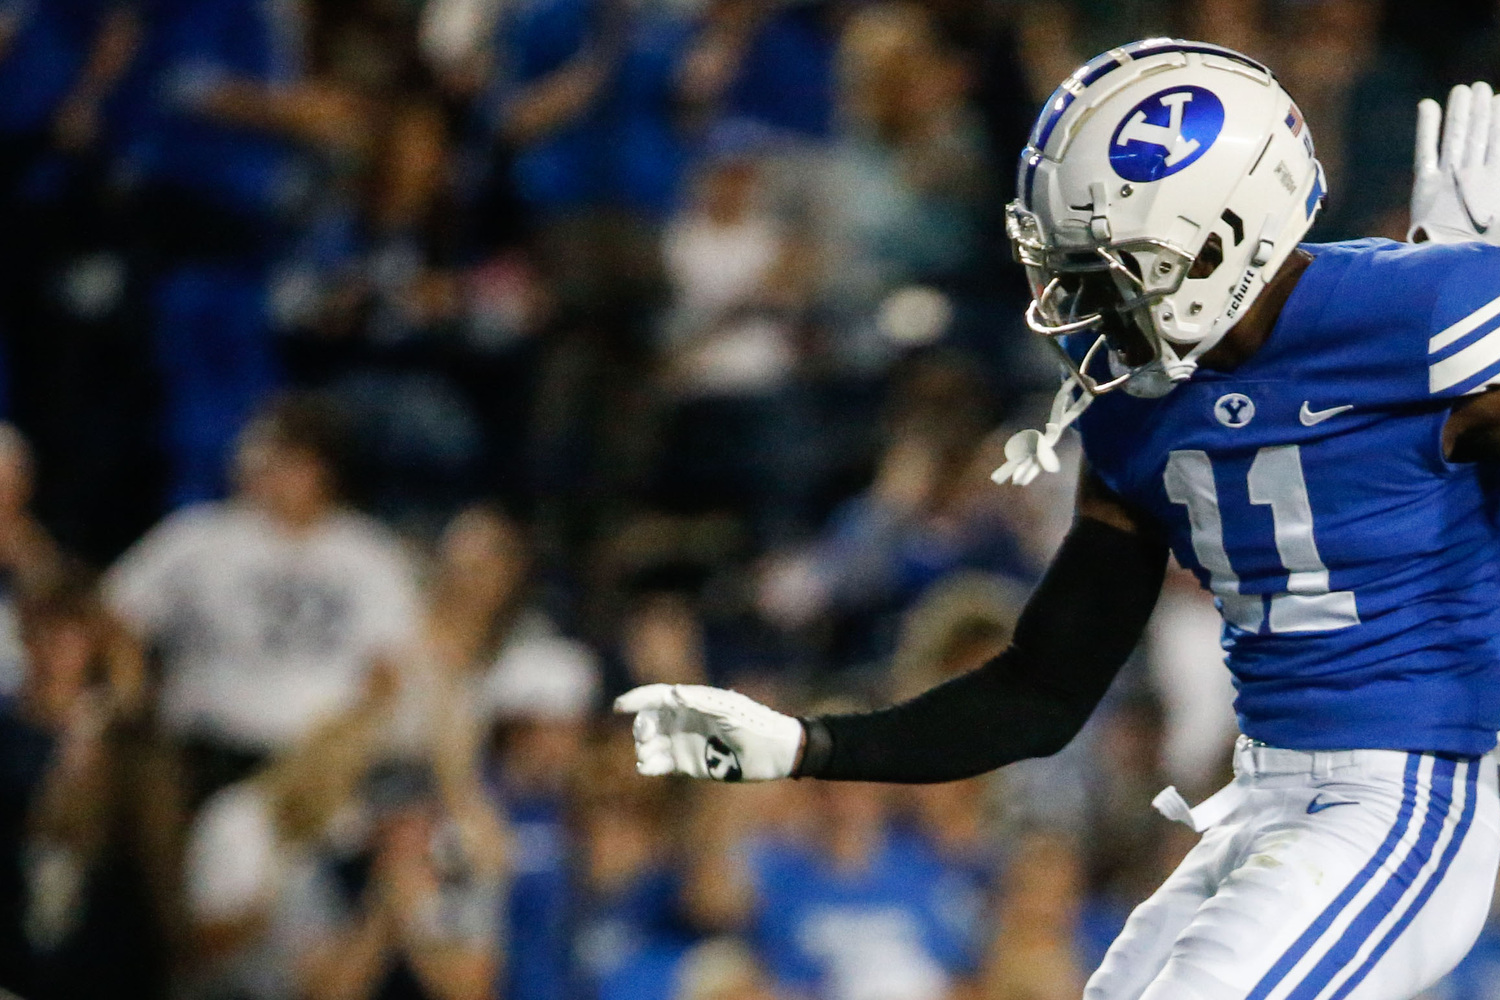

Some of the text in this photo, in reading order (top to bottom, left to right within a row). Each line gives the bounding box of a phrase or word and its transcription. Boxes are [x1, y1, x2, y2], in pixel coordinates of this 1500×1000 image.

[1116, 92, 1201, 168] Y
[1220, 399, 1248, 423] Y
[1163, 445, 1361, 634] 11
